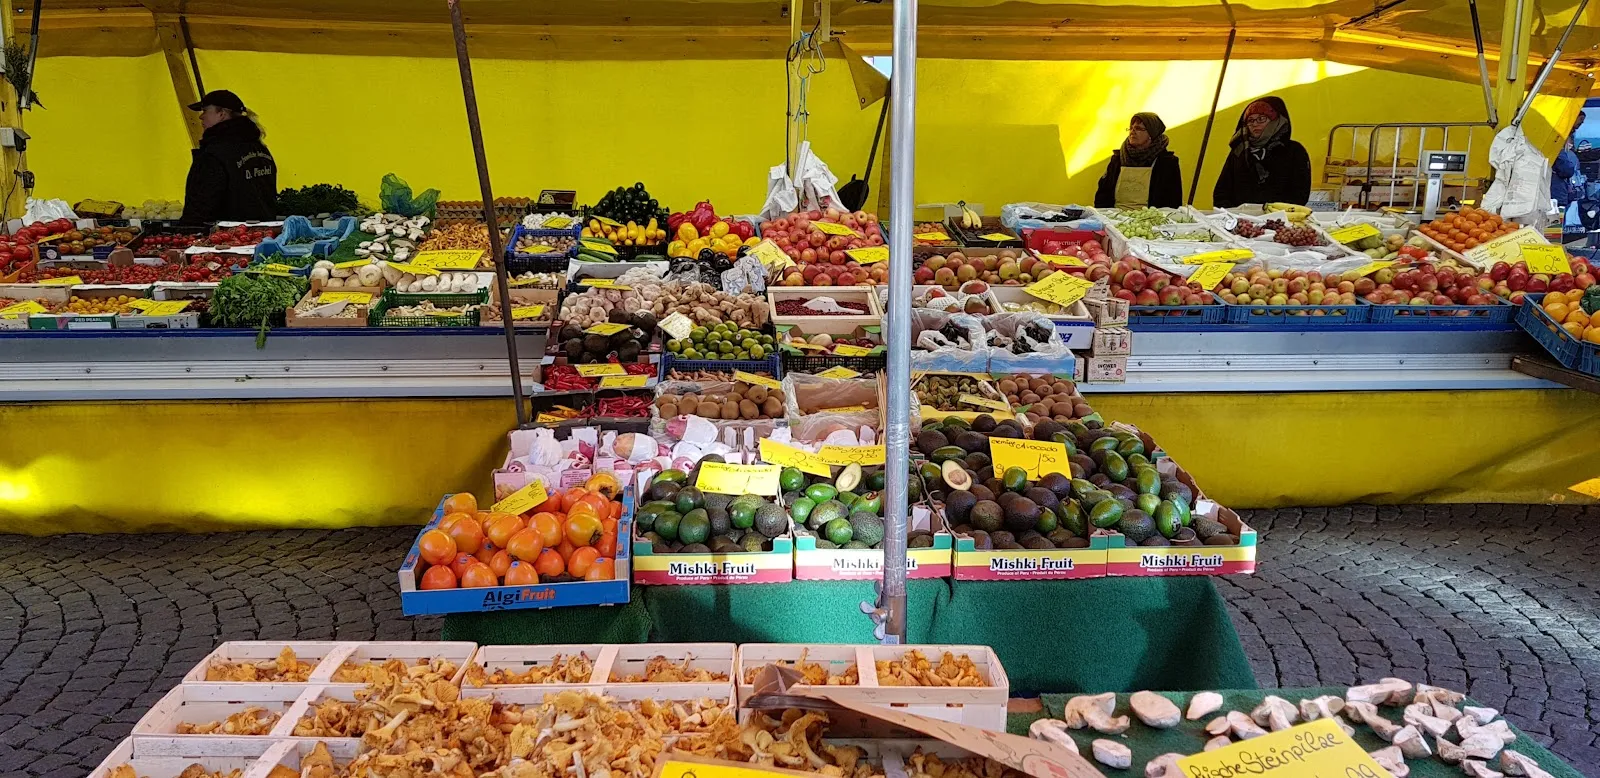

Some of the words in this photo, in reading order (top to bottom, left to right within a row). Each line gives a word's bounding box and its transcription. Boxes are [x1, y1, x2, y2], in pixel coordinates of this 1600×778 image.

[834, 558, 879, 568] Mishki
[991, 558, 1036, 569] Mishki
[1042, 558, 1073, 568] Fruit
[1142, 555, 1186, 566] Mishki
[1192, 555, 1223, 565] Fruit
[670, 563, 717, 574] Mishki
[722, 562, 754, 574] Fruit
[1239, 732, 1343, 774] Steinpilze
